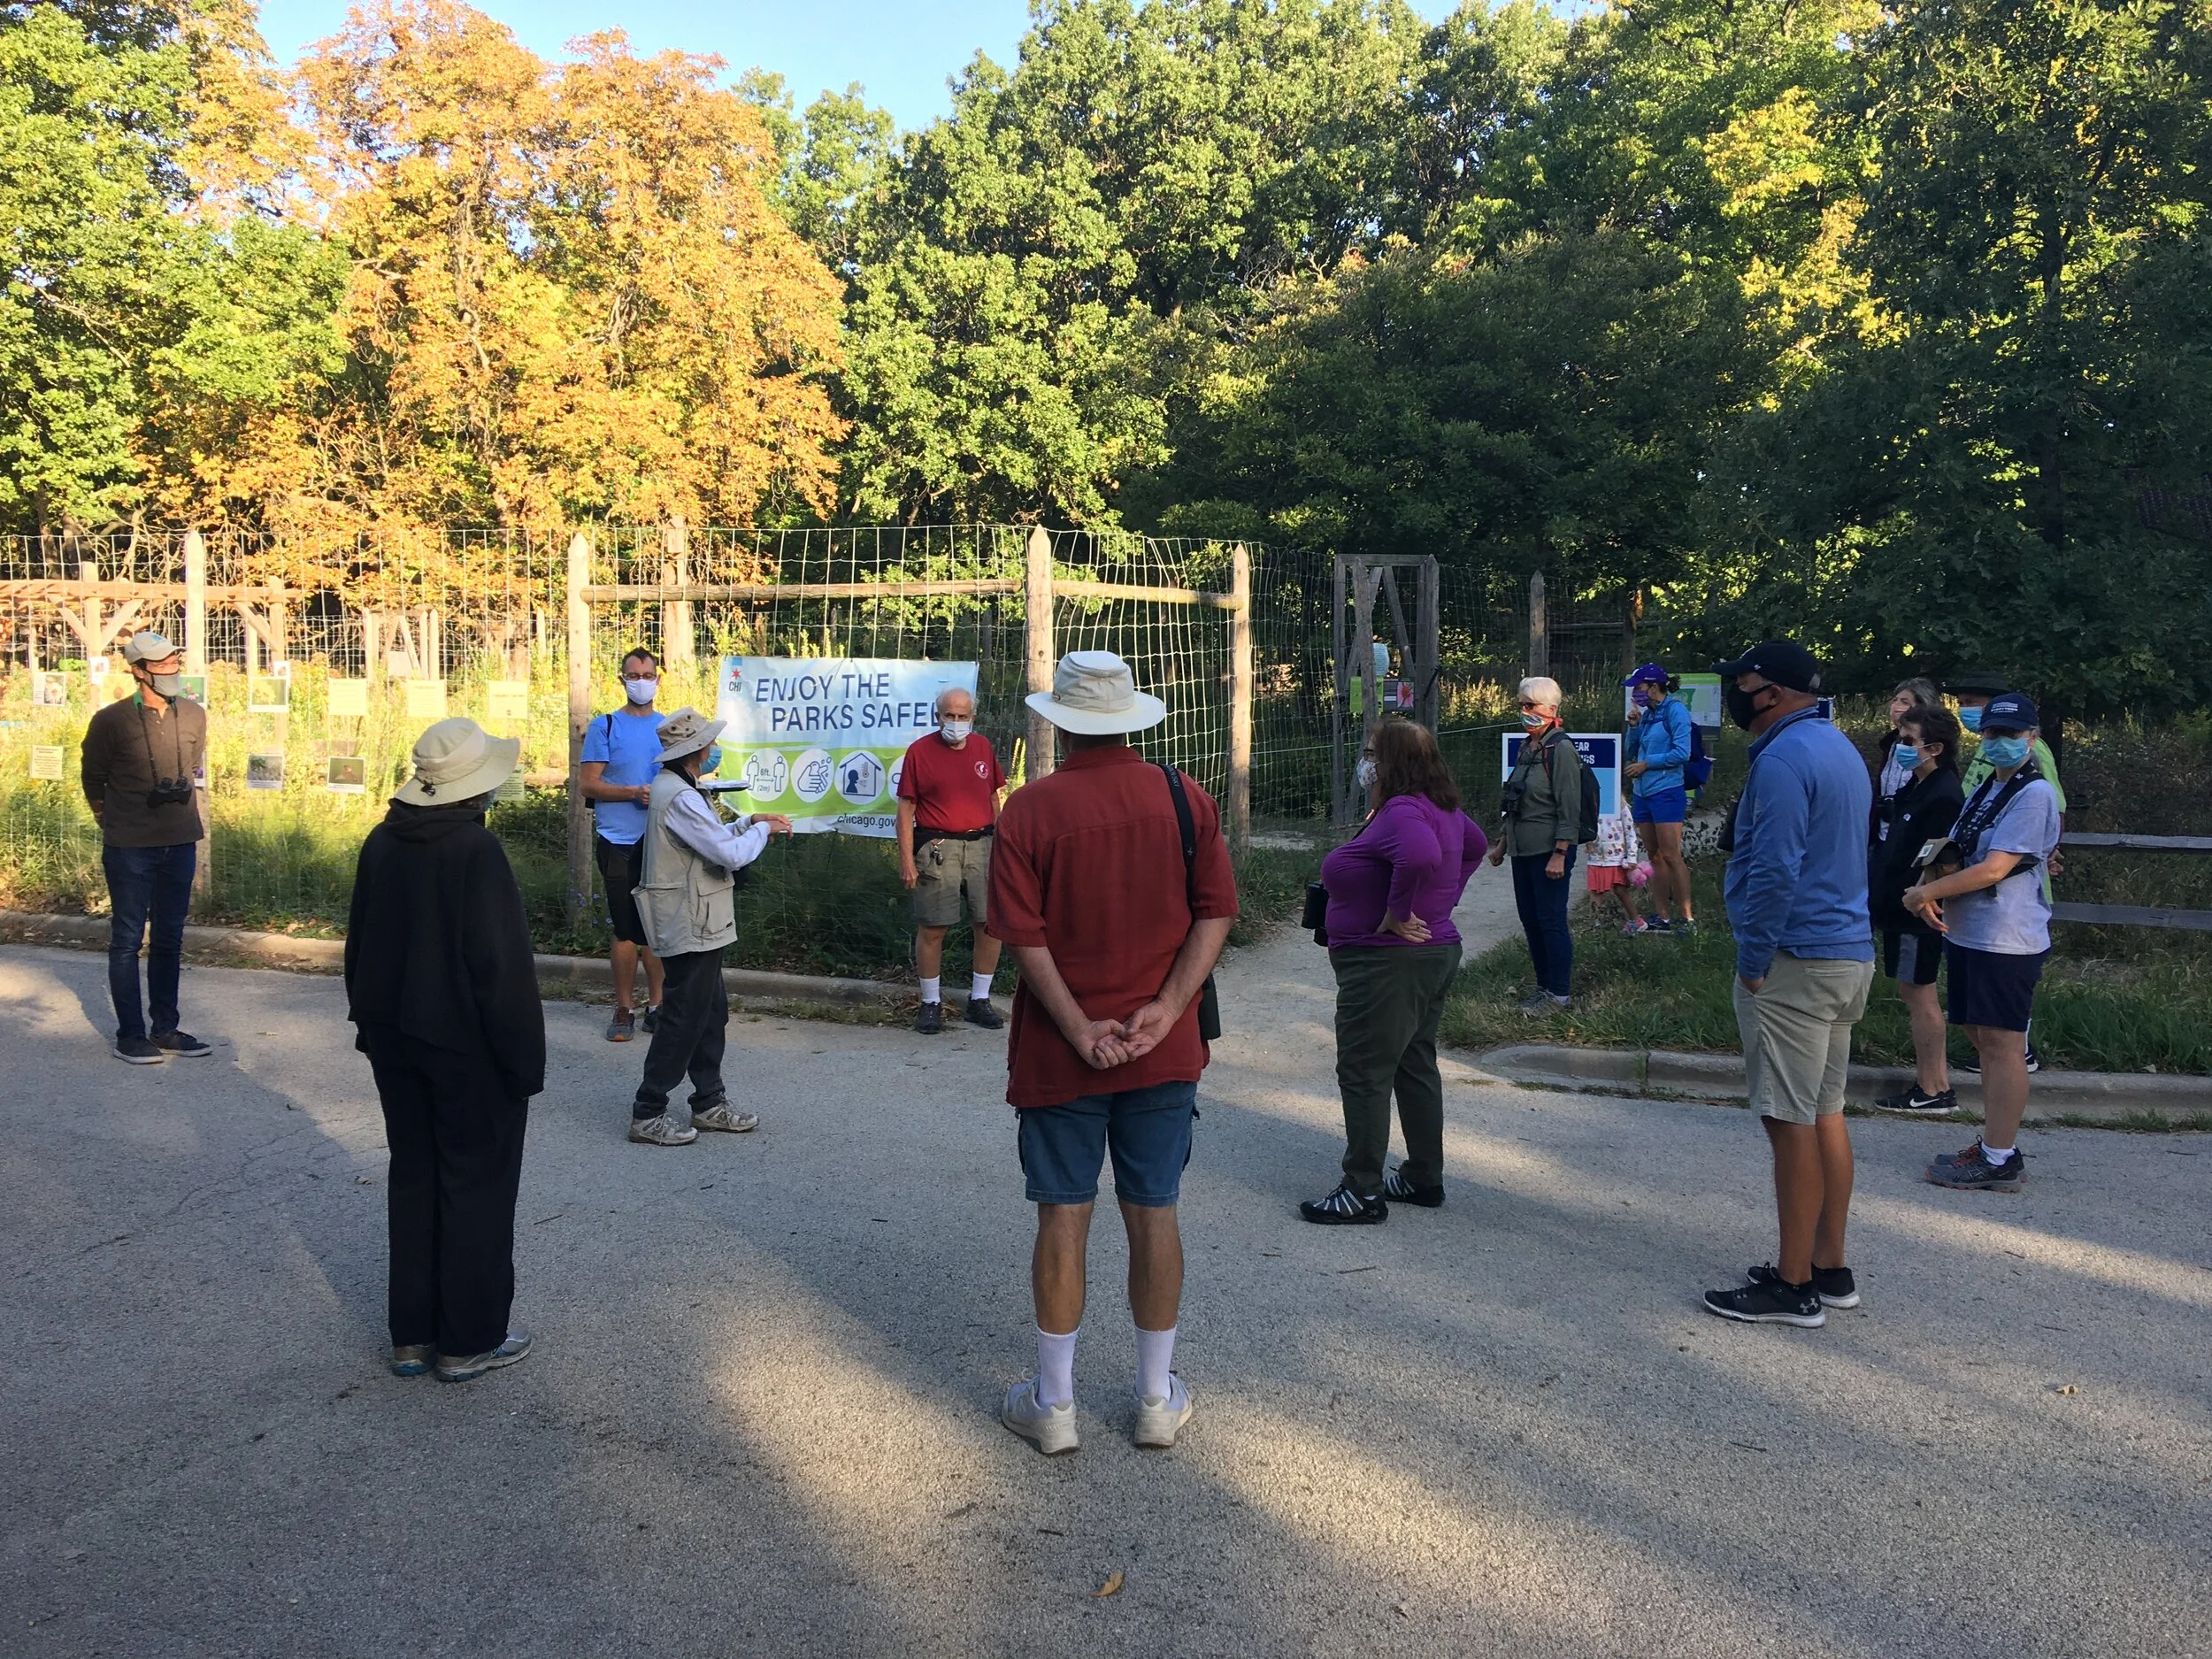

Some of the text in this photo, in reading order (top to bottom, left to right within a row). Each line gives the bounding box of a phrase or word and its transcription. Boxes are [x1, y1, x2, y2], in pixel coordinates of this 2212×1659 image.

[728, 681, 742, 692] CHI
[756, 672, 889, 703] ENJOY THE
[772, 703, 941, 732] PARKS SAFEL
[1574, 741, 1590, 752] EAR
[837, 813, 896, 829] chicago.gov
